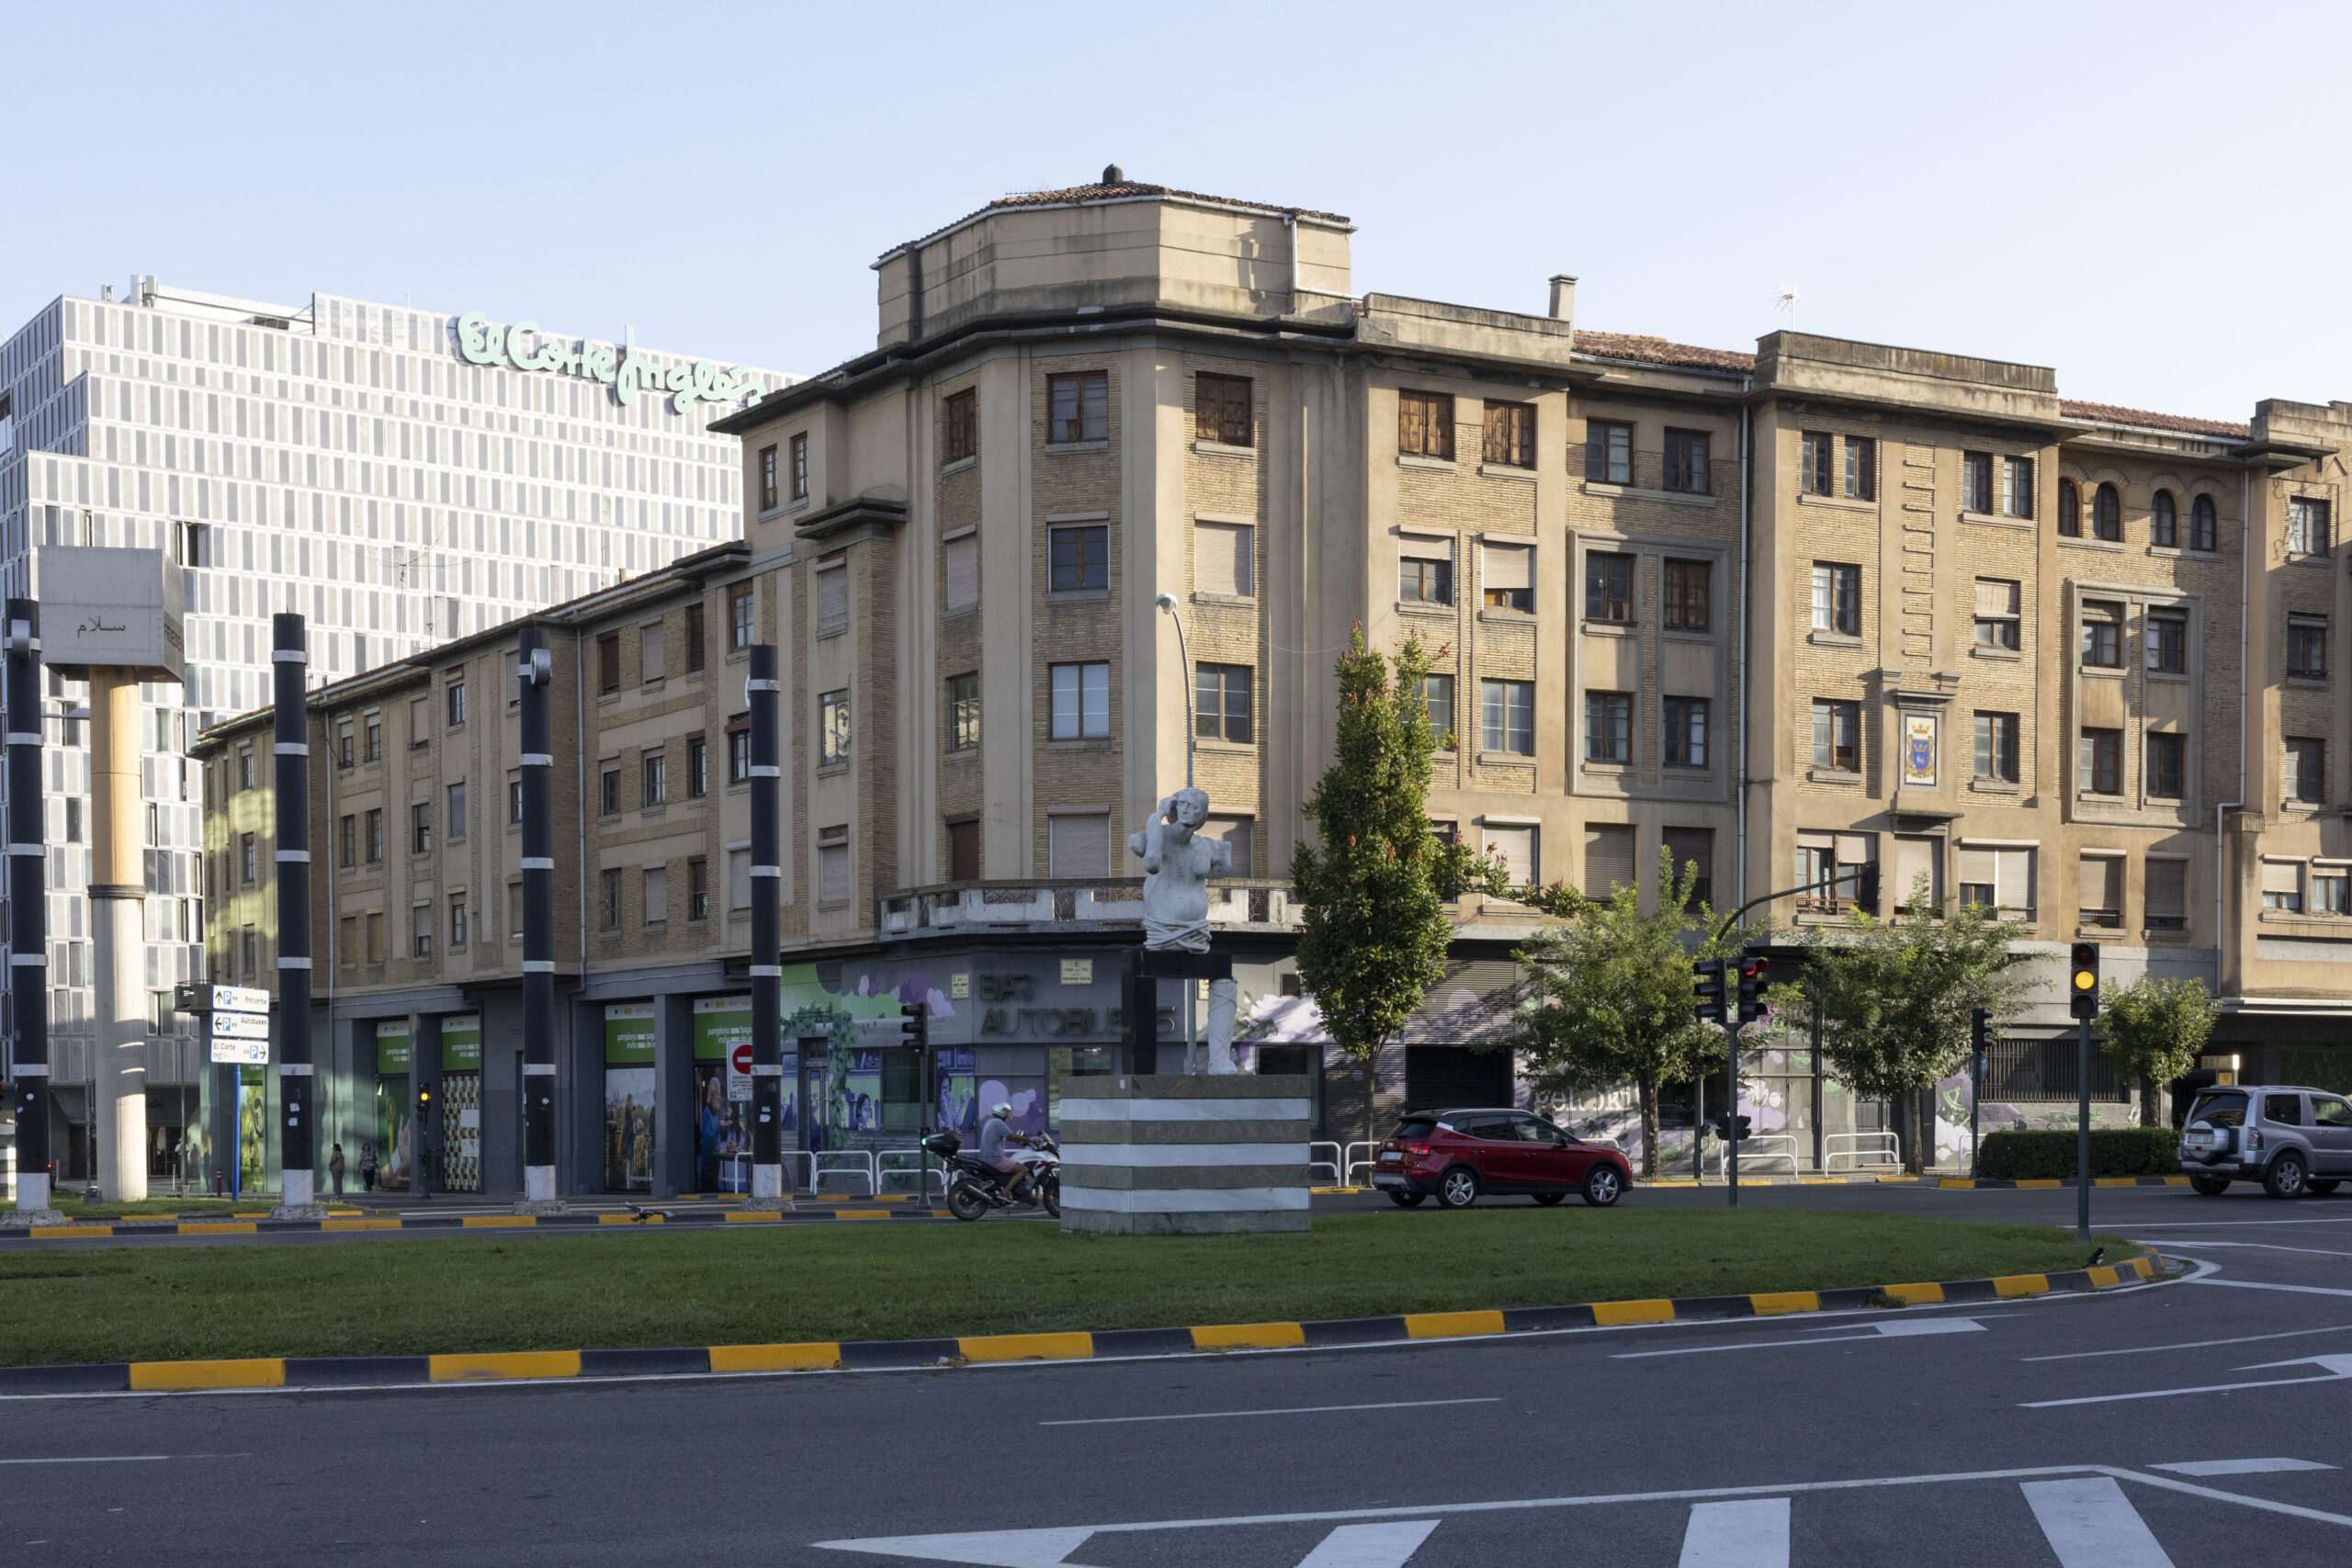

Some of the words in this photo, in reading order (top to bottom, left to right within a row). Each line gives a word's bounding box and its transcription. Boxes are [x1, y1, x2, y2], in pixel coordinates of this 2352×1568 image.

[458, 310, 508, 366] El
[506, 321, 616, 384] Corte
[77, 615, 126, 639] سلام
[980, 974, 1035, 1000] BAR
[980, 1007, 1176, 1036] AUTOBUSS
